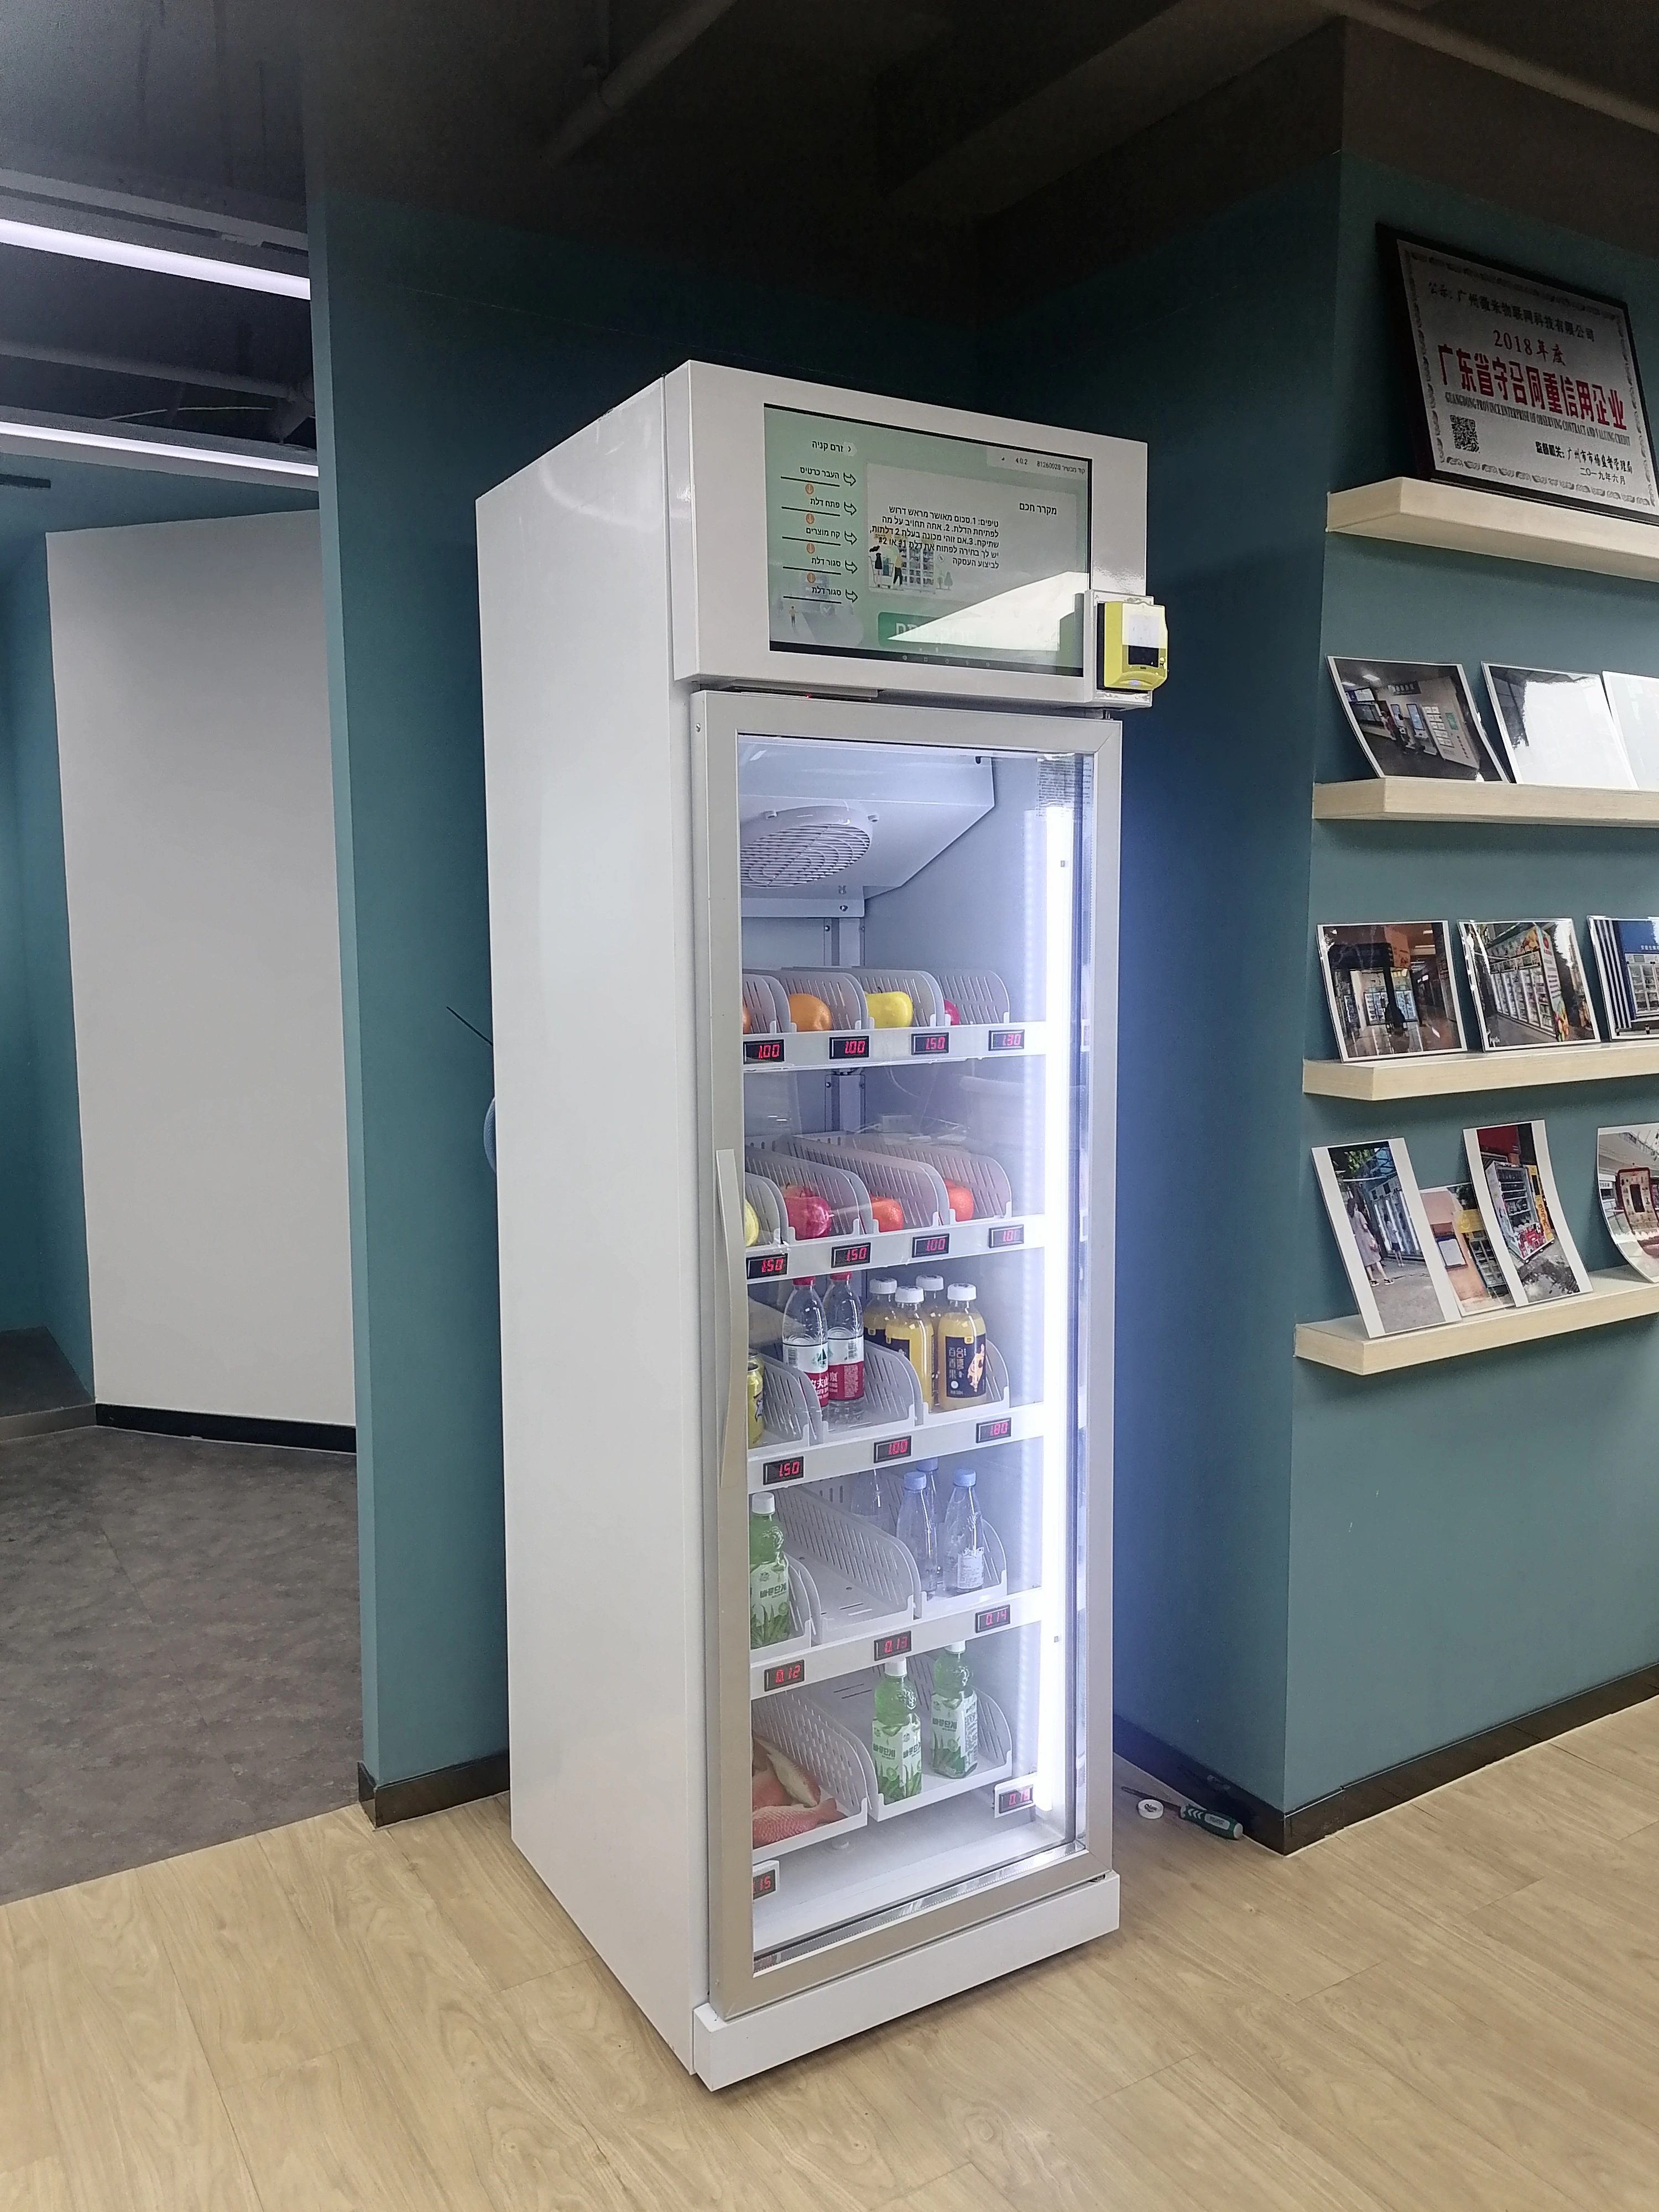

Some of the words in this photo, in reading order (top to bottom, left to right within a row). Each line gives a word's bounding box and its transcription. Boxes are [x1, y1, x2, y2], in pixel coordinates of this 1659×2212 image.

[1438, 343, 1627, 430] 广东省守合同重信用企业
[812, 441, 828, 451] קניה
[830, 444, 843, 452] זרם
[800, 466, 820, 476] כרטיס
[821, 469, 839, 479] העבר
[810, 497, 824, 506] דלת
[889, 505, 906, 515] דרוש
[1019, 502, 1035, 512] חכם
[1037, 505, 1057, 515] מקרר
[907, 508, 928, 518] מראש
[930, 512, 952, 521] מאושר
[882, 515, 893, 524] מה
[894, 516, 904, 525] על
[905, 519, 925, 528] תחויב
[978, 519, 999, 528] טיפים:
[806, 527, 829, 536] מוצרים
[870, 525, 894, 535] דלתות,
[895, 528, 900, 536] 2
[901, 528, 920, 538] בעלת
[951, 525, 972, 535] הדלת.
[973, 529, 999, 538] לפתיחת
[831, 531, 841, 539] קח
[922, 532, 941, 541] מכונה
[943, 535, 956, 543] זוהי
[909, 540, 922, 550] דלת
[924, 542, 935, 551] את
[974, 539, 999, 548] שתיקח.
[936, 544, 957, 554] לפתוח
[959, 547, 979, 556] בחירה
[981, 549, 989, 559] לך
[811, 556, 825, 565] דלת
[953, 557, 976, 567] העסקה
[978, 560, 999, 569] לביצוע
[812, 586, 825, 594] דלת
